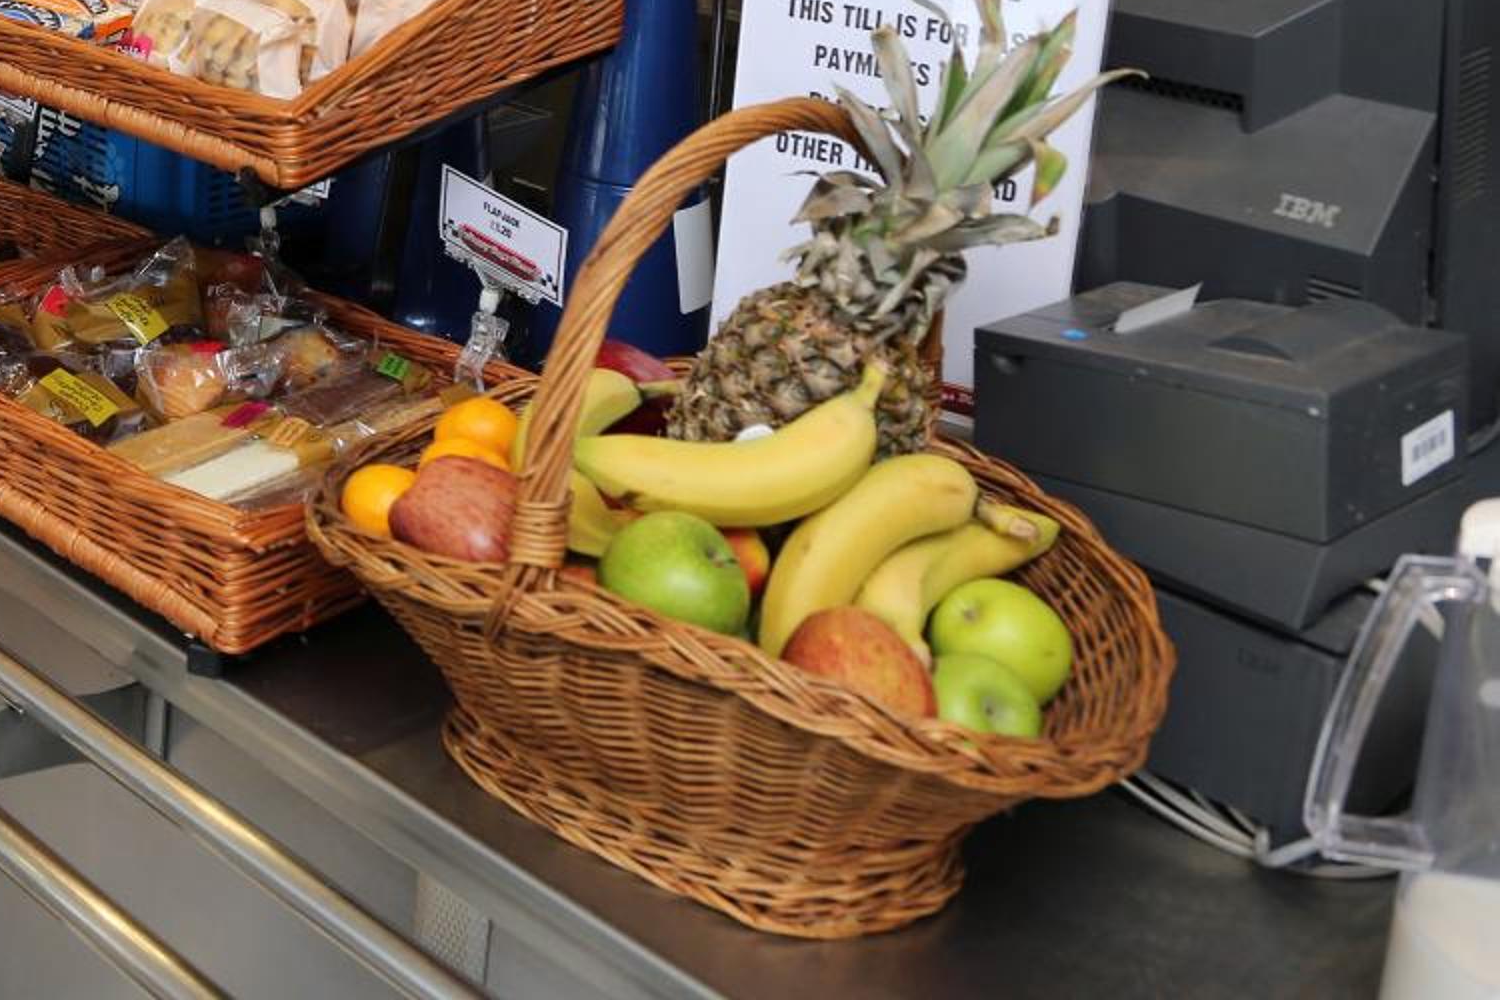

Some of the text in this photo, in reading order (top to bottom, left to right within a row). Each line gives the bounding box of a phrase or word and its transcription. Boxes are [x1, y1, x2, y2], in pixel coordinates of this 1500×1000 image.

[843, 4, 883, 31] TILL
[896, 12, 918, 38] IS
[925, 17, 968, 47] FOR
[776, 132, 844, 166] OTHER
[1273, 192, 1341, 229] IBM
